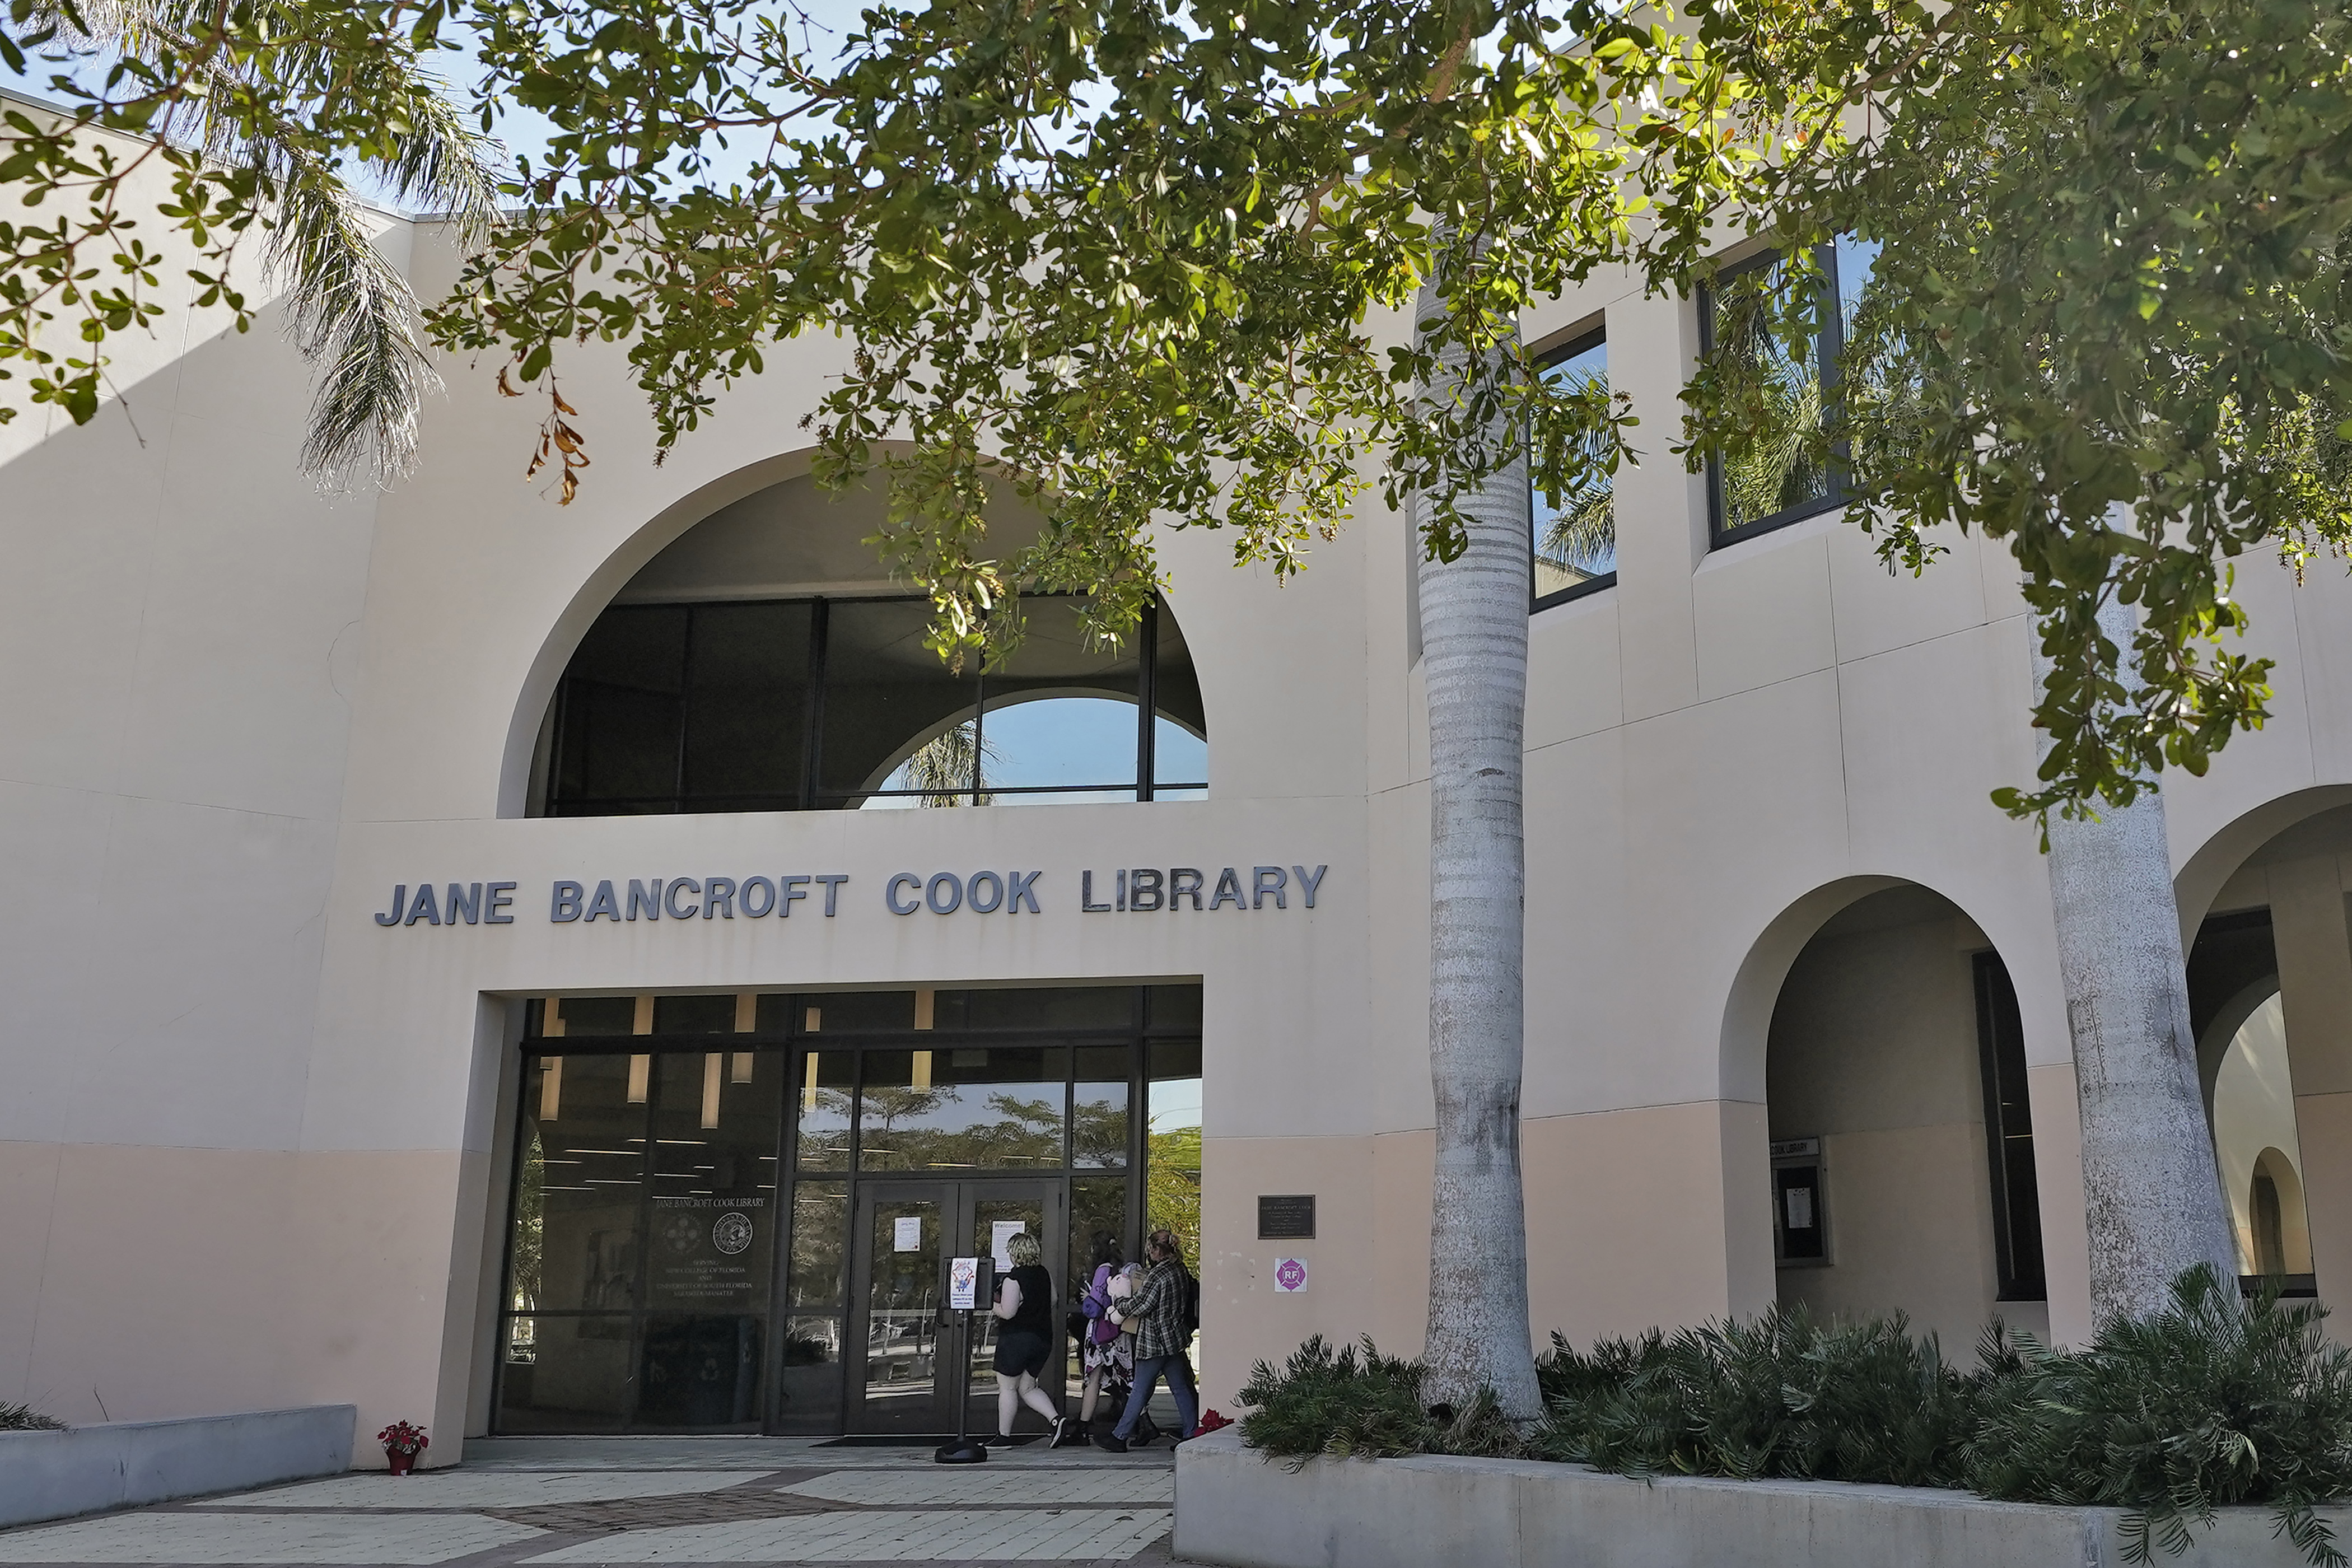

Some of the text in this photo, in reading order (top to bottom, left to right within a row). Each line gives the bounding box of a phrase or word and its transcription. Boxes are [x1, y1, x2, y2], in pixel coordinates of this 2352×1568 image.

[374, 865, 1328, 926] JANE BANCROFT COOK LIBRARY
[713, 1198, 735, 1207] COOK
[736, 1197, 765, 1207] LIBRARY
[1284, 1271, 1298, 1280] RF
